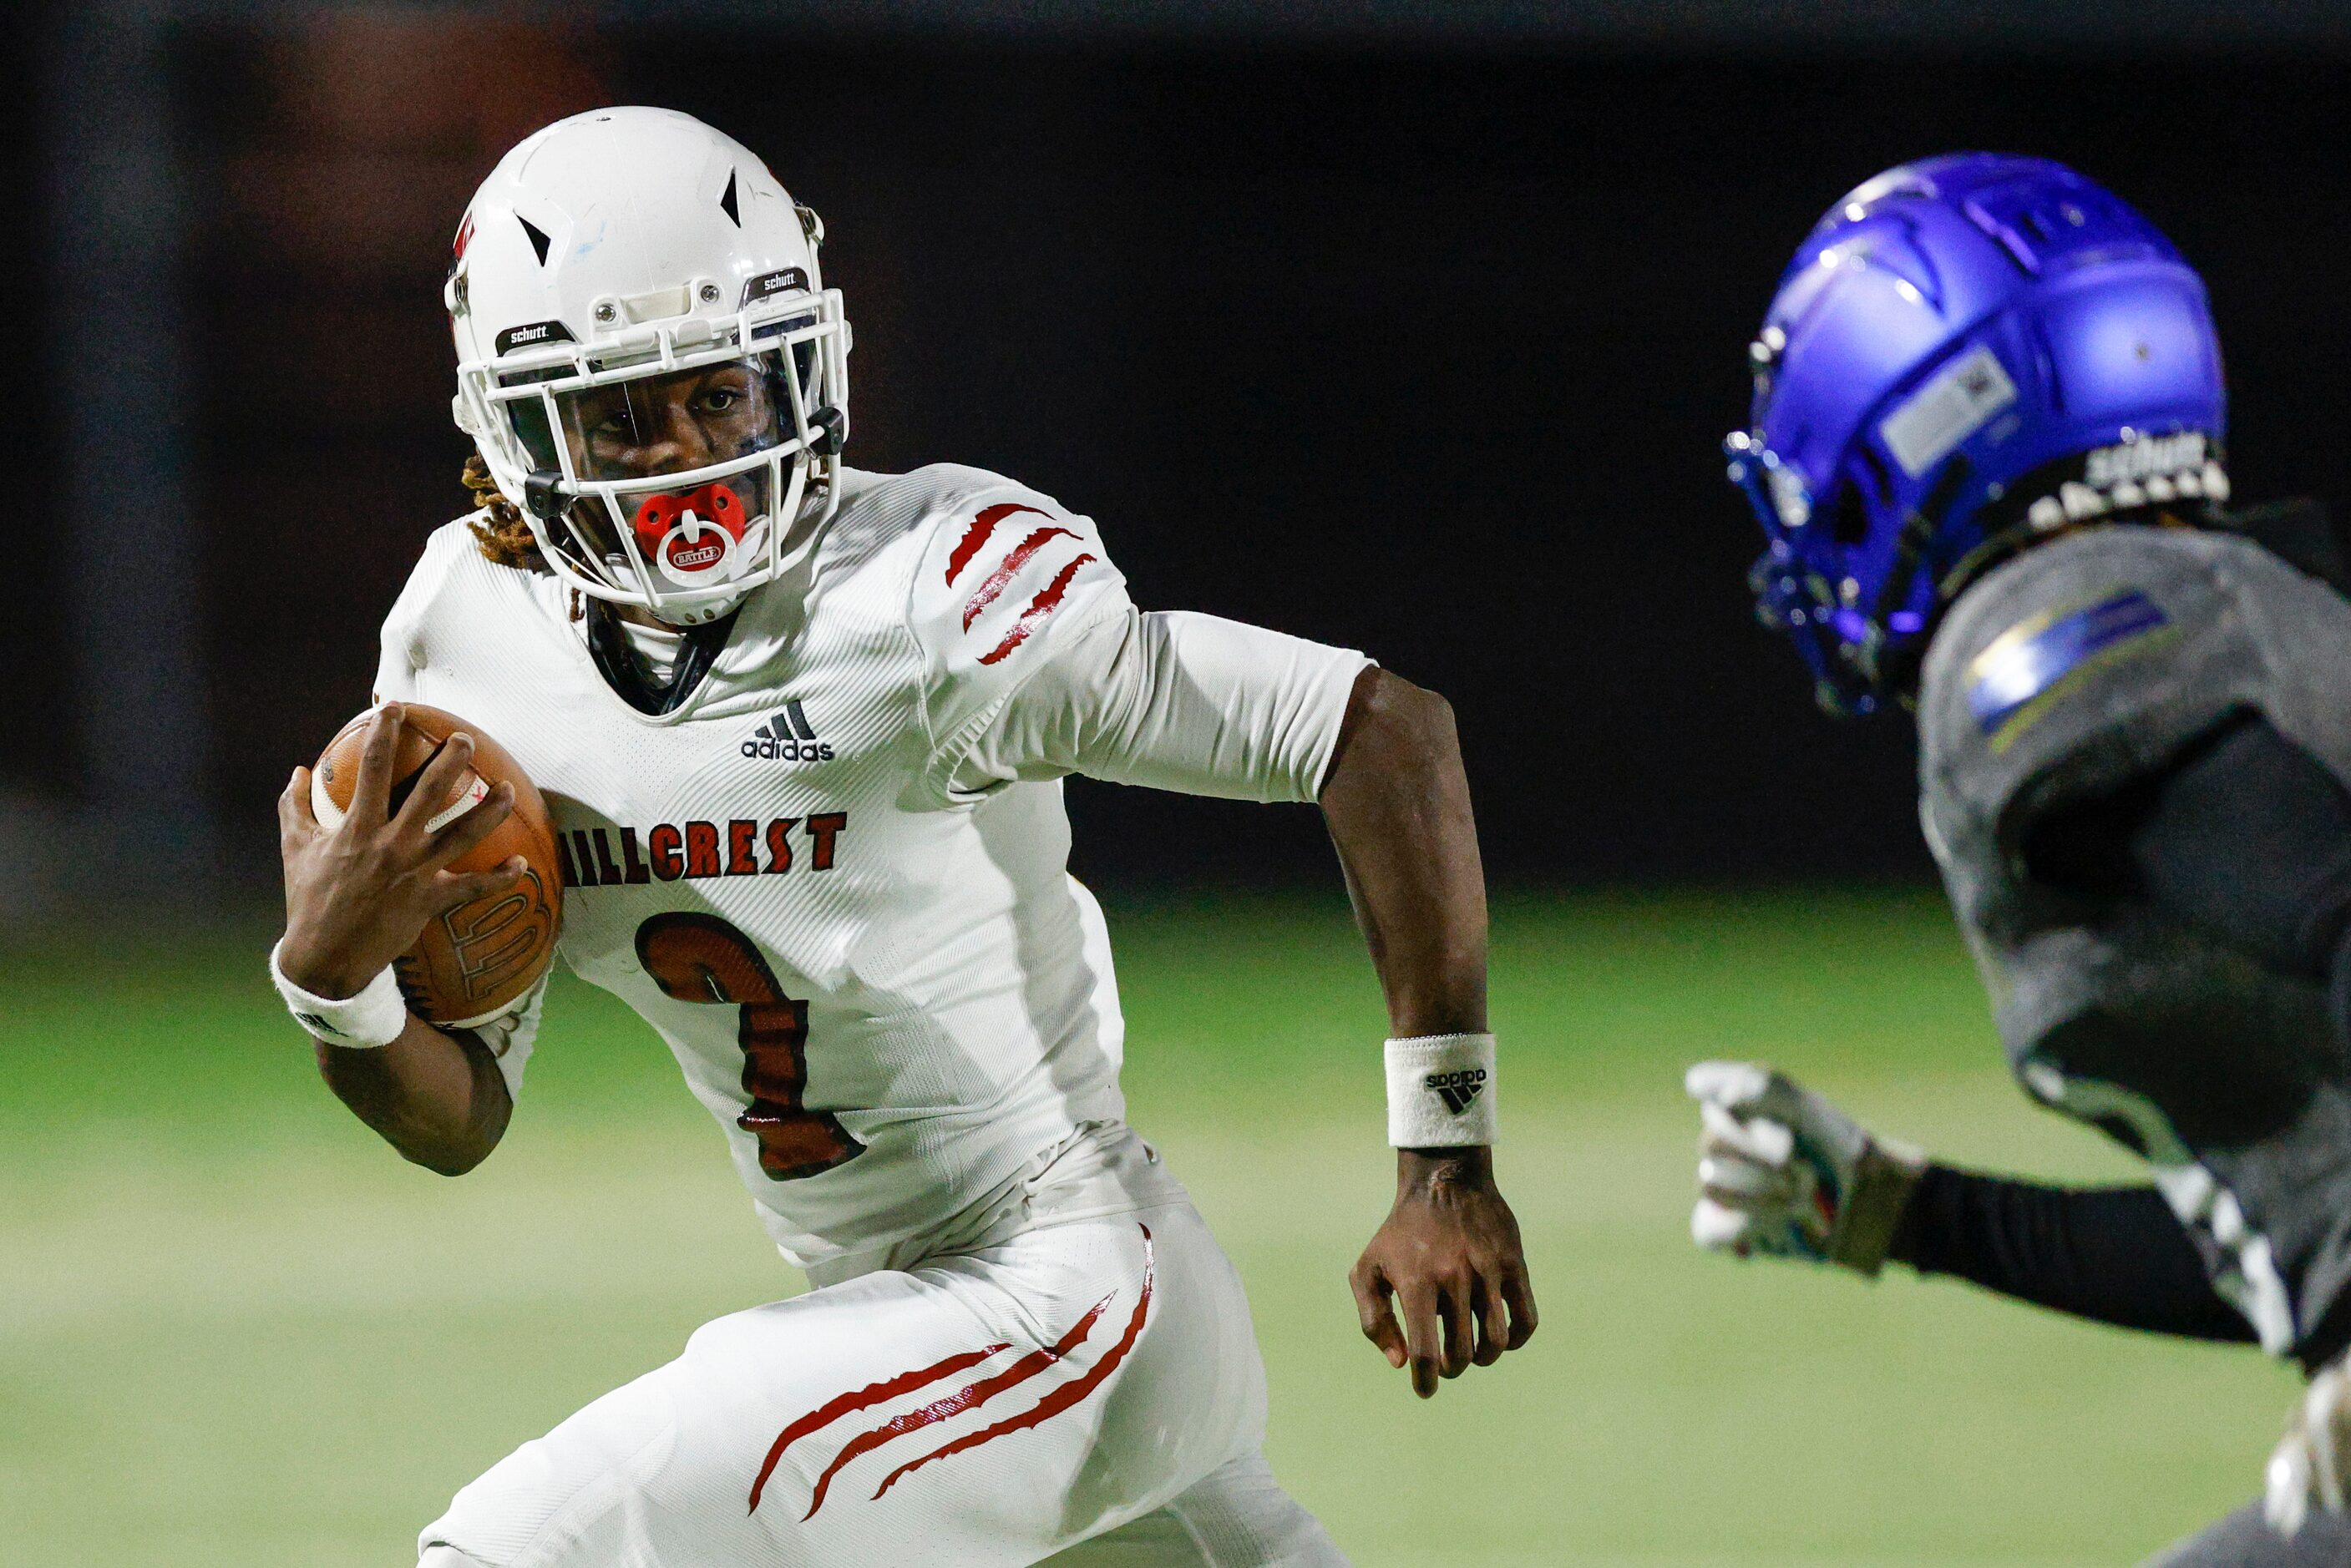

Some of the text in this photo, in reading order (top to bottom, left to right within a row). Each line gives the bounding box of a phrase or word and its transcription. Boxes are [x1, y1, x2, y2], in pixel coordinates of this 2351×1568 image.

[764, 272, 794, 291] schutt
[510, 326, 547, 343] schutt
[677, 549, 717, 564] BATTLE
[741, 737, 834, 761] adidas
